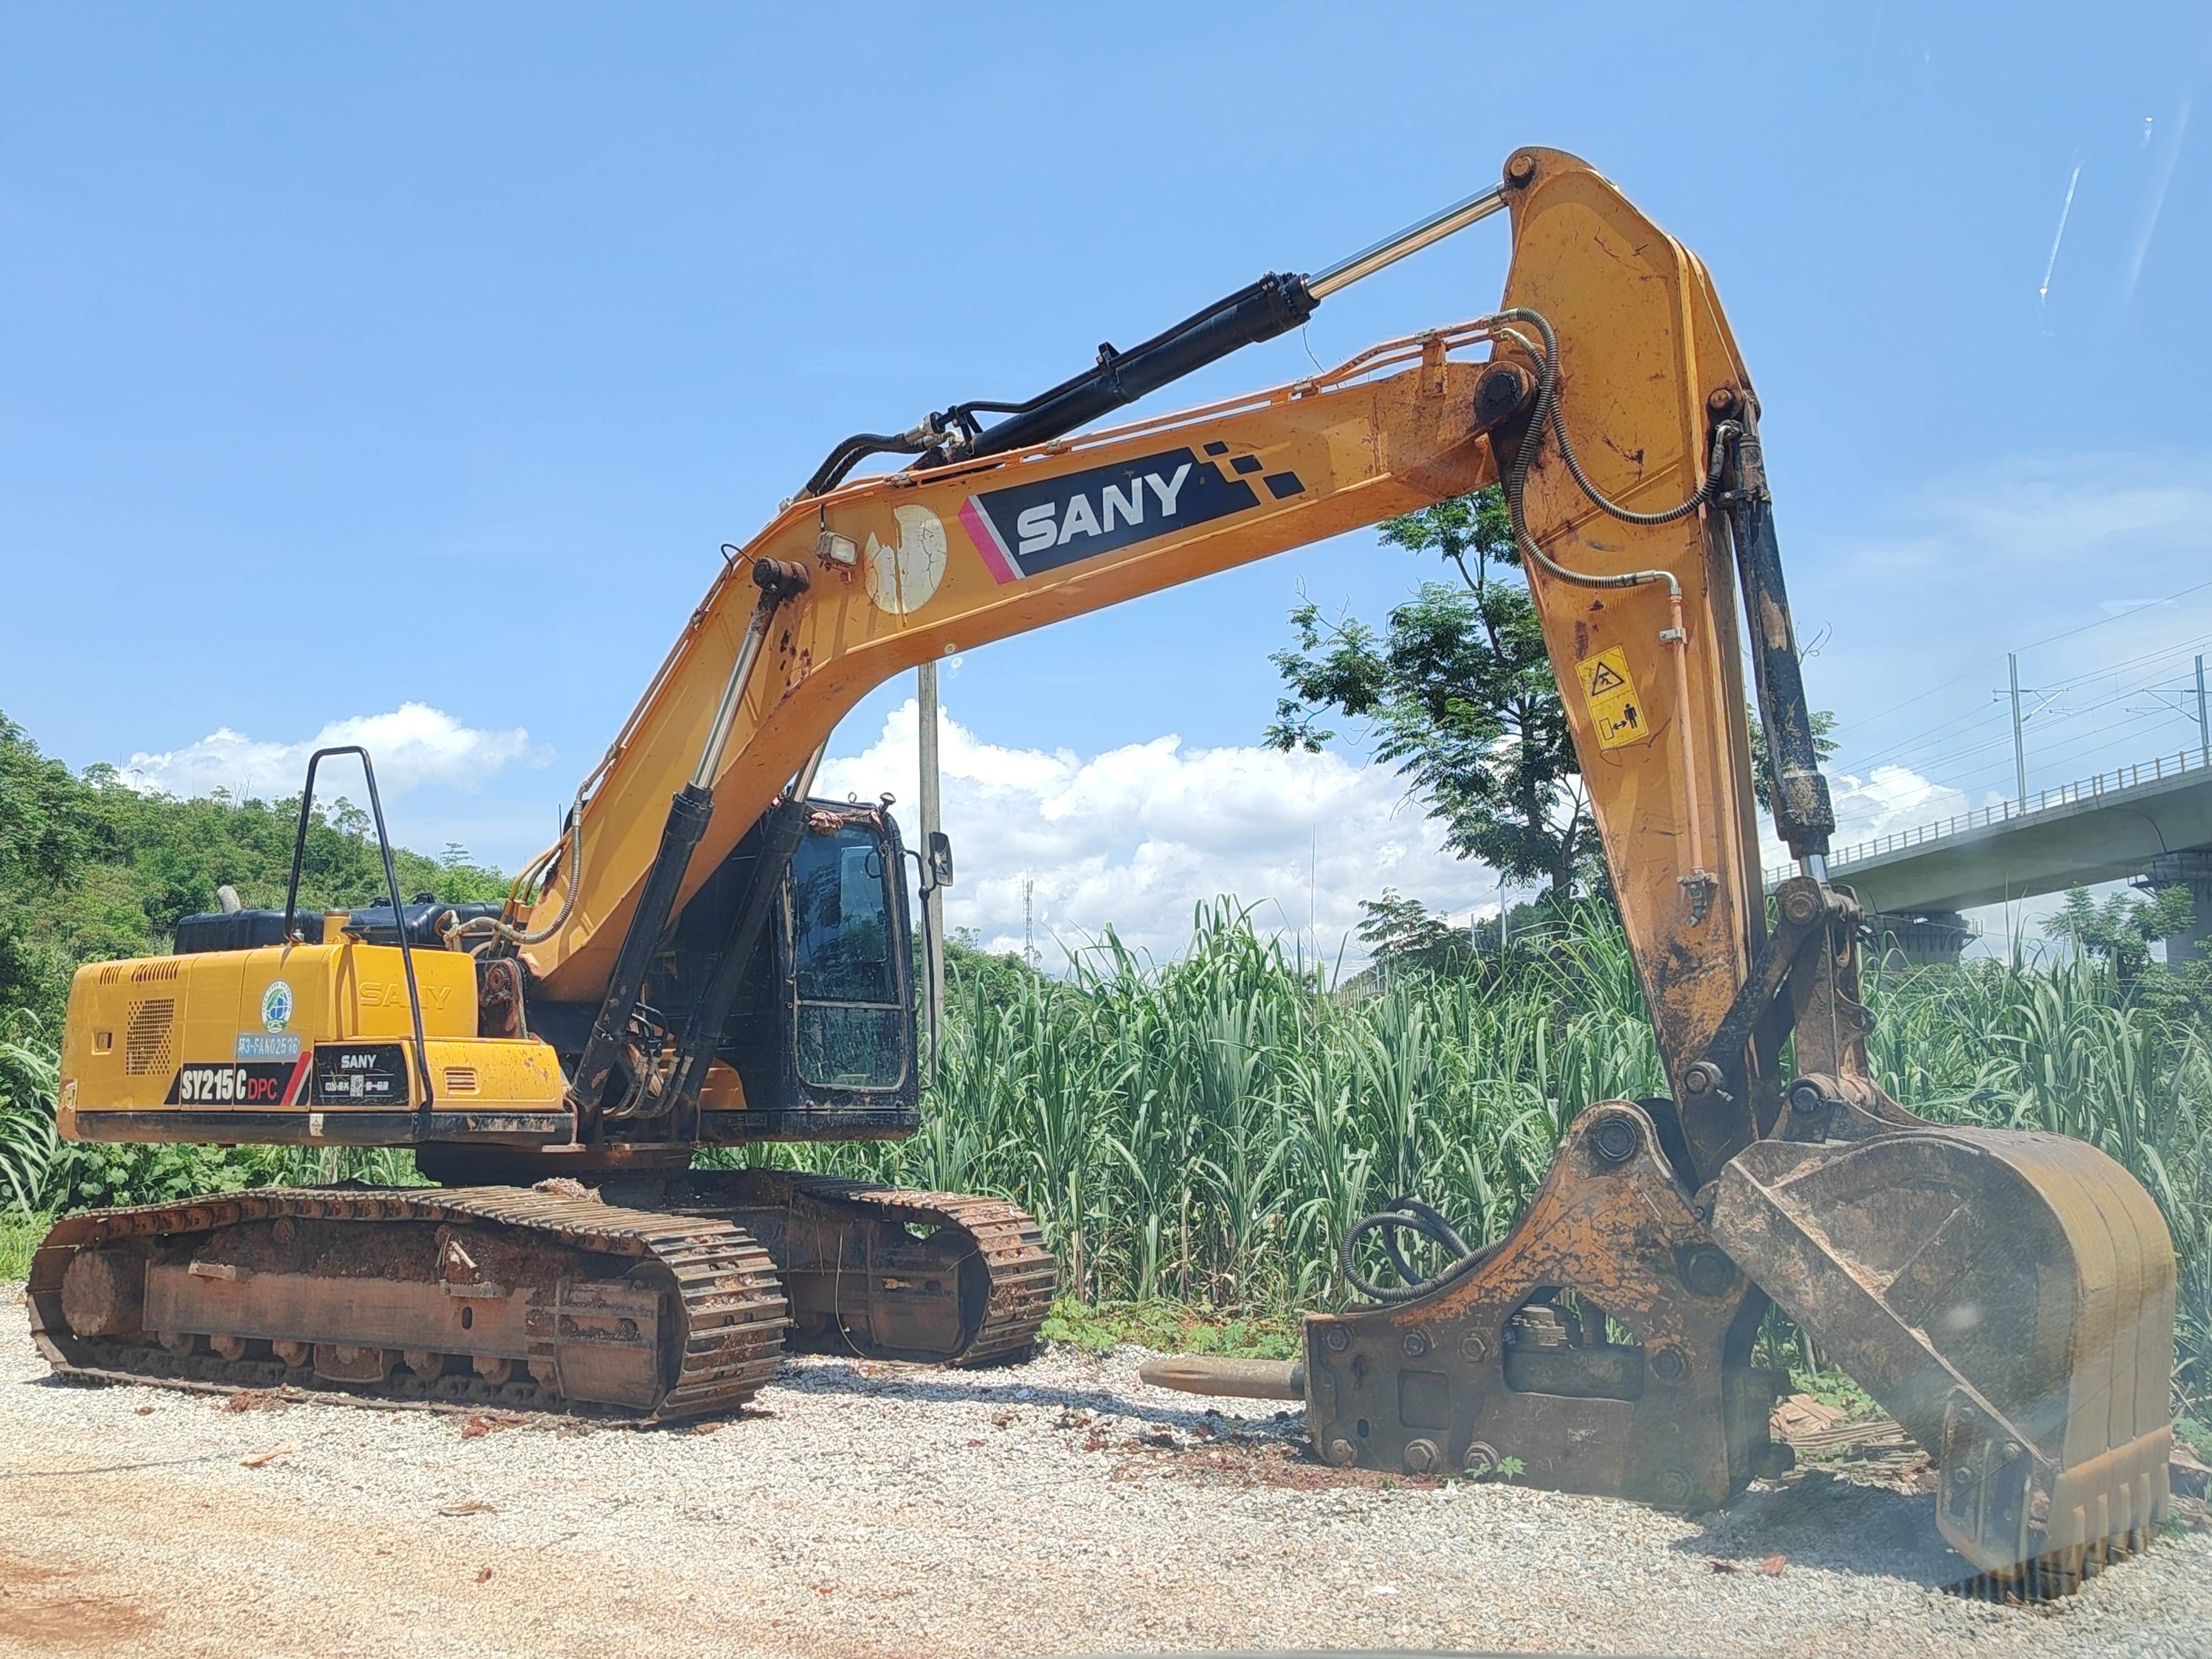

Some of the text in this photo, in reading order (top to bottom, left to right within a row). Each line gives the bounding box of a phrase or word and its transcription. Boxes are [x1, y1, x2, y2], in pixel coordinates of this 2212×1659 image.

[1017, 462, 1192, 556] SANY
[341, 1054, 377, 1068] SANY
[181, 1068, 278, 1100] SY215C DPC
